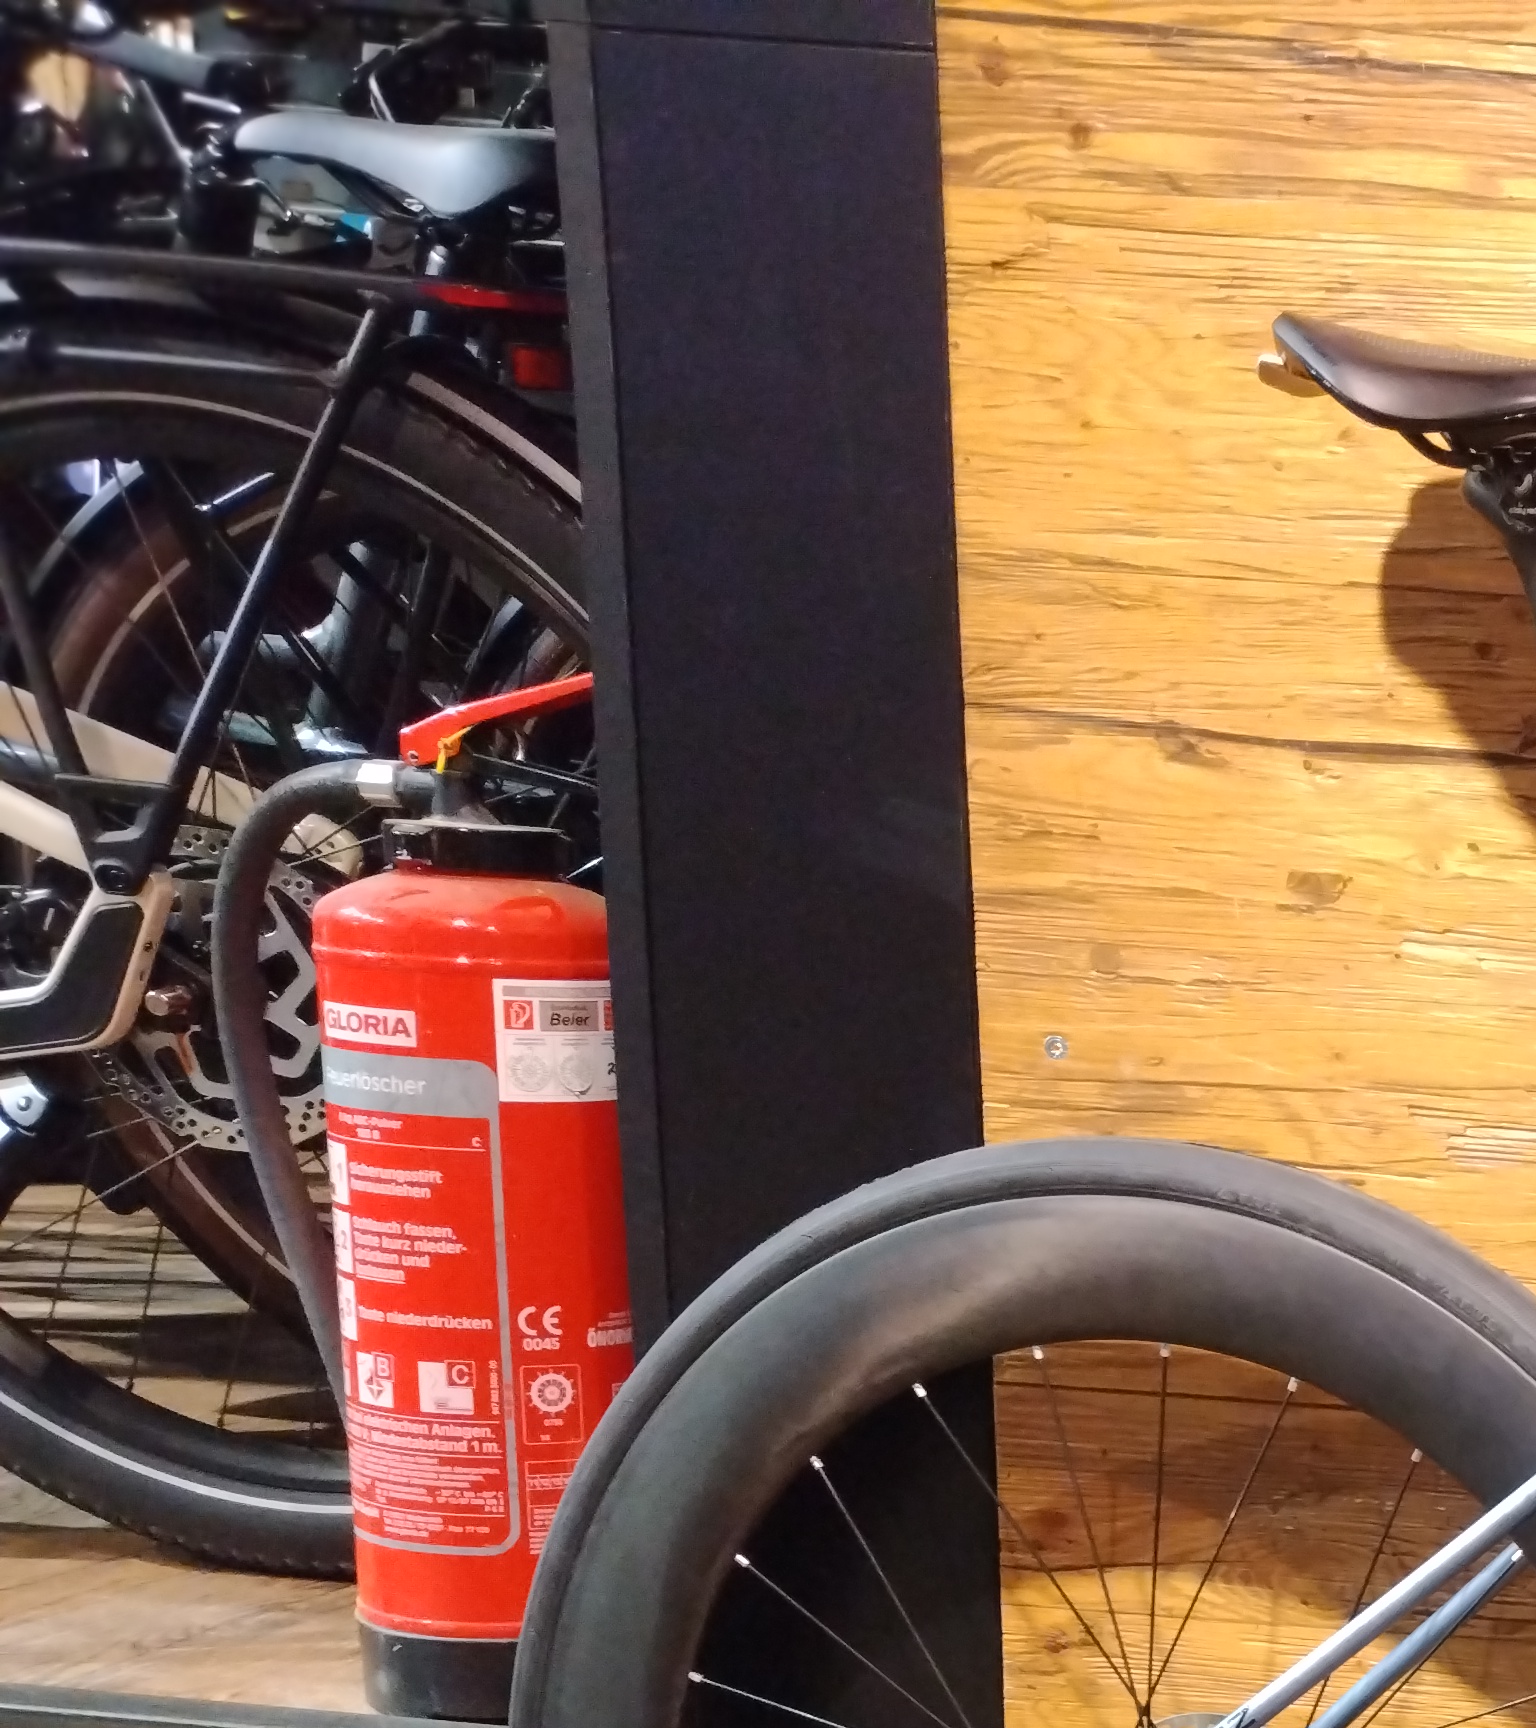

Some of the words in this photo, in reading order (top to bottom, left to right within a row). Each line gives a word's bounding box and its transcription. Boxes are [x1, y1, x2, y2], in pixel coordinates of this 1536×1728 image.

[325, 1007, 412, 1038] GLORIA
[517, 1305, 563, 1336] CE
[523, 1338, 560, 1350] 0045
[451, 1364, 470, 1385] C
